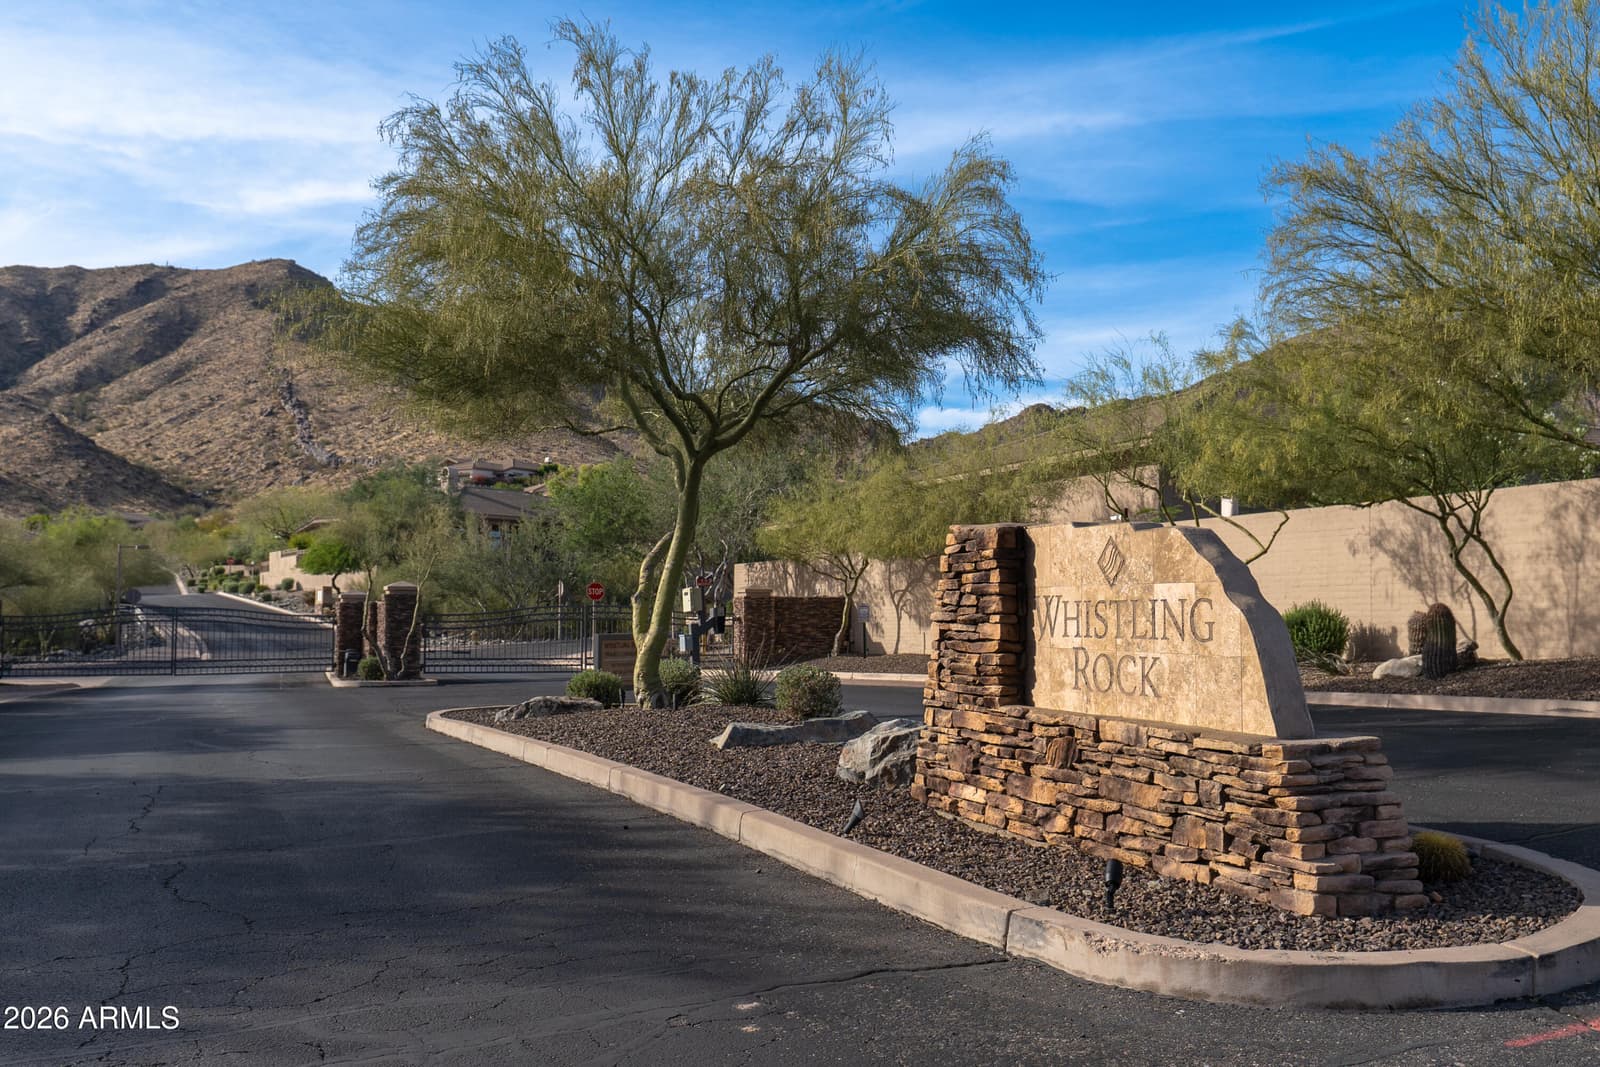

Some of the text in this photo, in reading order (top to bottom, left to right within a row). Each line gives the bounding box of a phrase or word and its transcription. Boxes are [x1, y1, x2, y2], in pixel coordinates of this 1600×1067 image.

[588, 587, 604, 595] STOP
[1035, 595, 1215, 643] WHISTLING
[1072, 646, 1161, 698] ROCK
